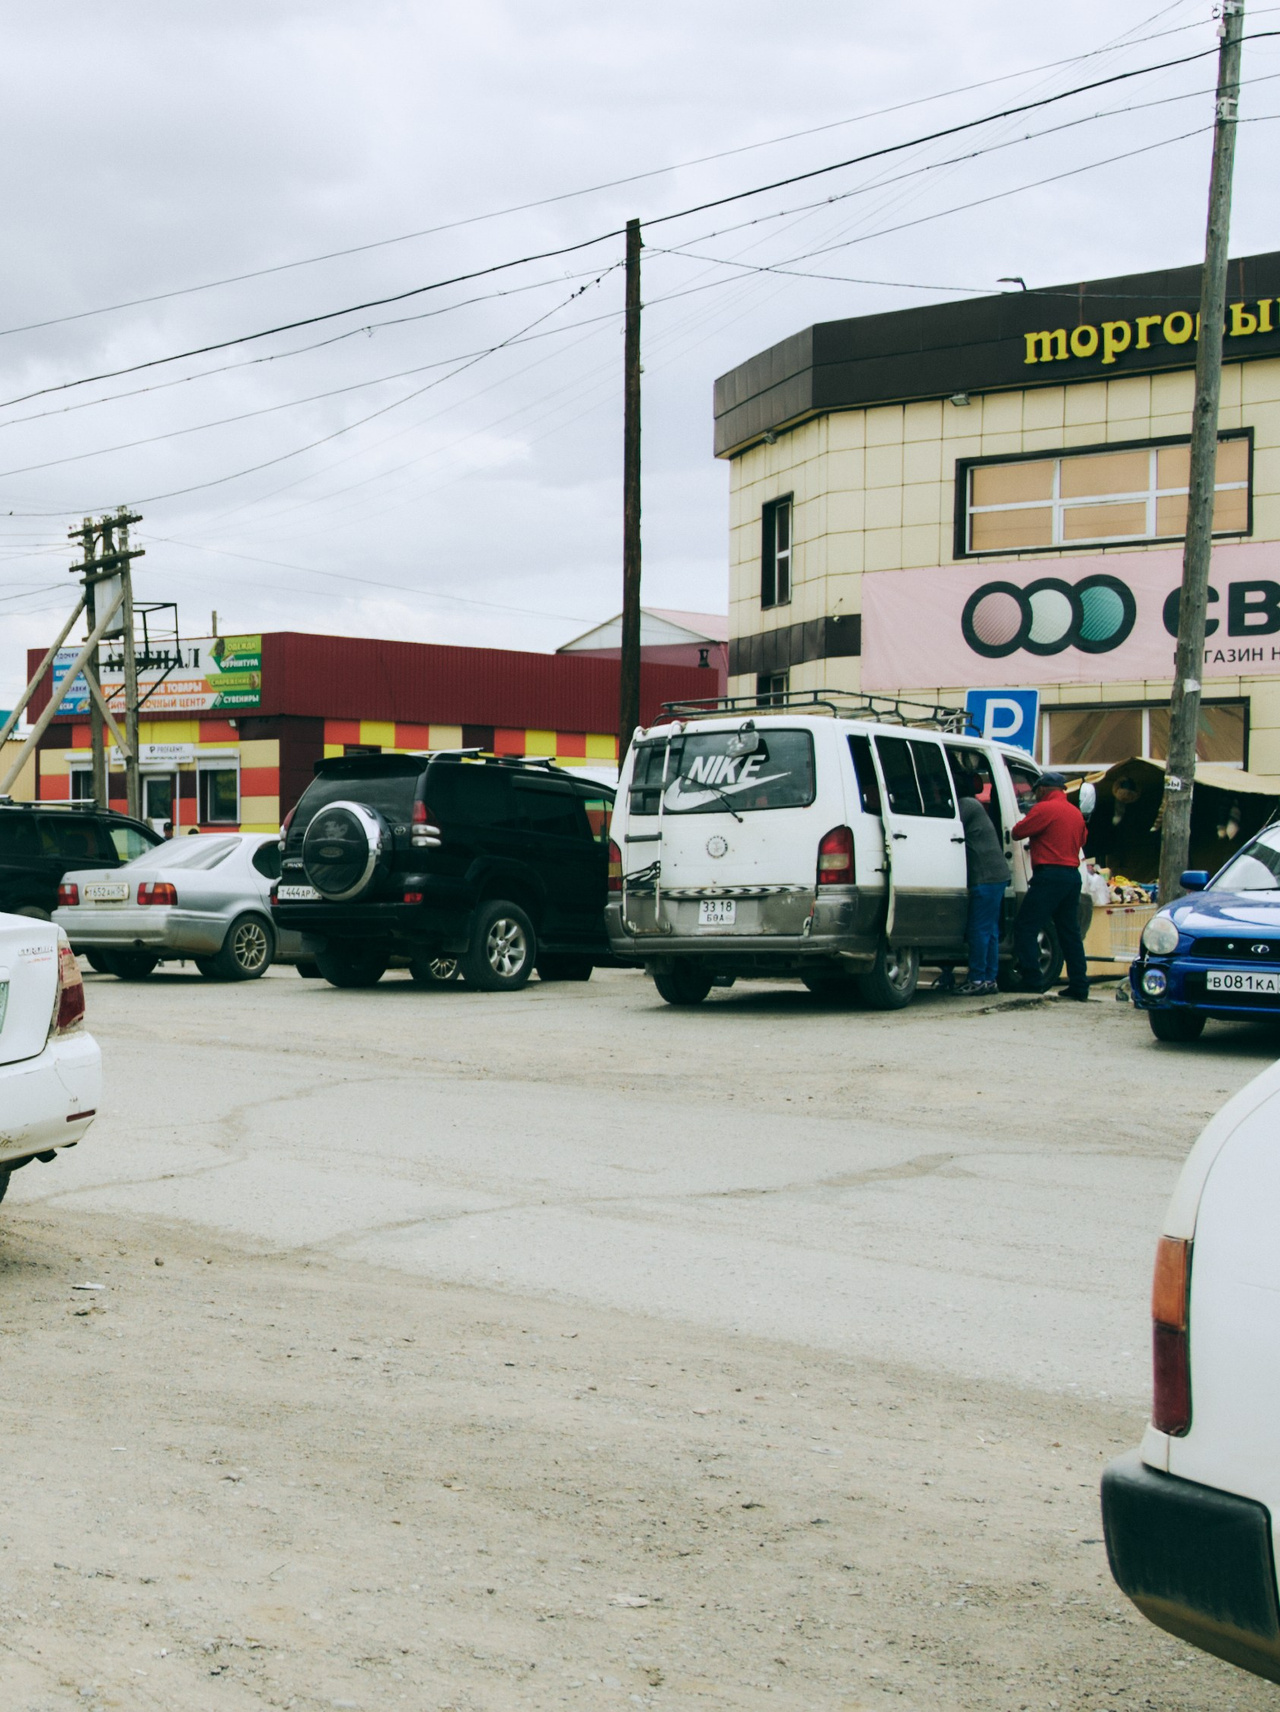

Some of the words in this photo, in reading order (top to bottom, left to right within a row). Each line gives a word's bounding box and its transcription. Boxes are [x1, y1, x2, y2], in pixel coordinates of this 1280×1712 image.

[1024, 297, 1280, 364] торгоы
[227, 642, 256, 651] ОДЕЖДА
[103, 648, 200, 673] АСЕНАЛ
[1173, 647, 1263, 665] ГАЗИН
[220, 659, 259, 669] ФУРНИТУРА
[167, 681, 202, 693] ТОВАРЫ
[181, 697, 206, 708] ЦЕНТР
[223, 695, 259, 704] СУВЕНИРЫ
[983, 698, 1024, 740] P
[684, 754, 766, 785] NIKE
[703, 901, 716, 913] 33
[721, 901, 732, 912] 18
[1213, 974, 1275, 991] В081КА
